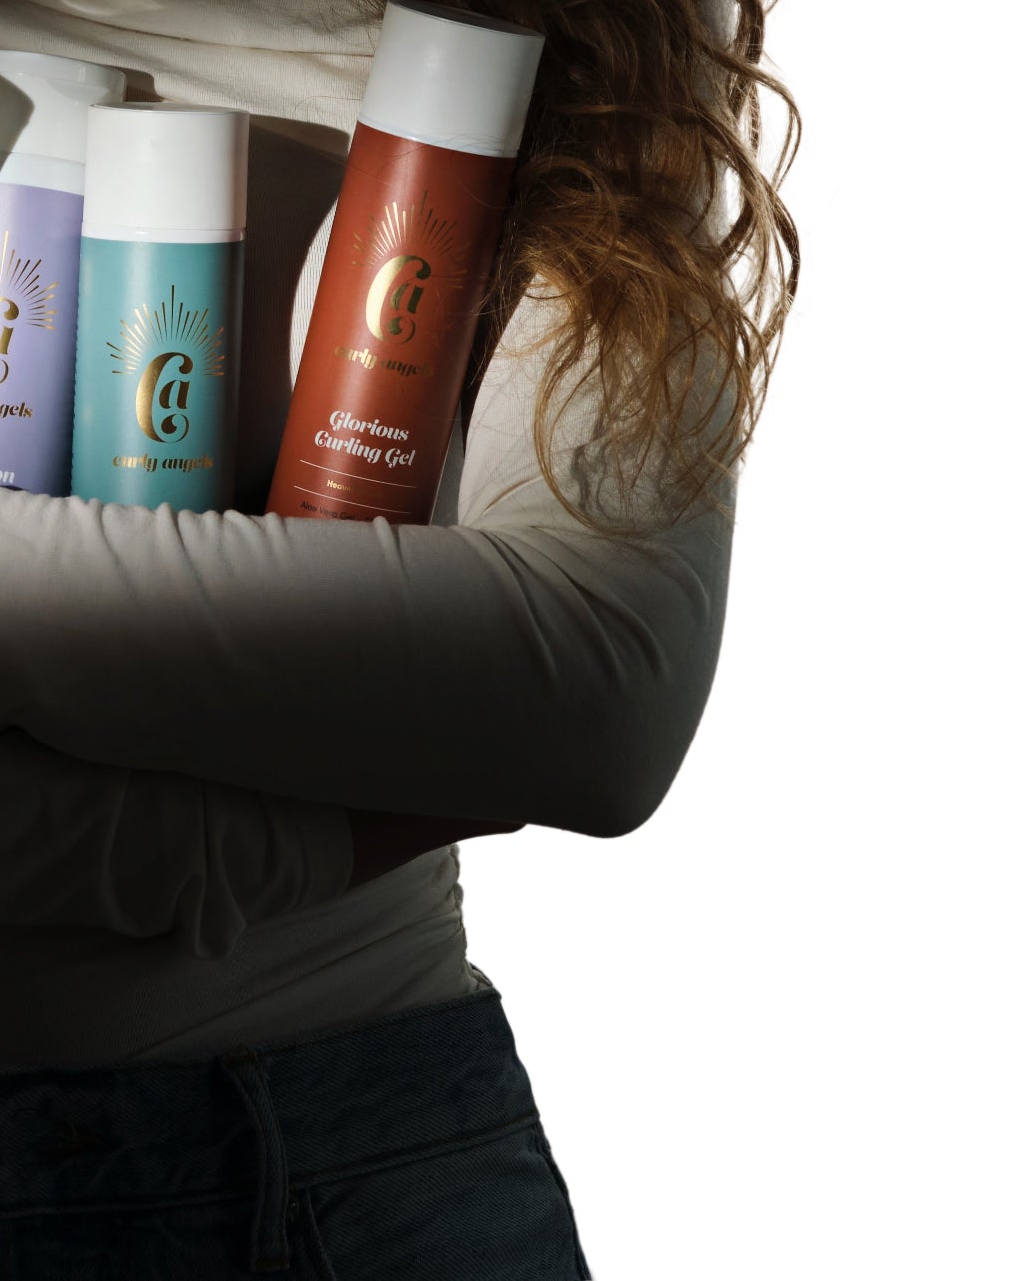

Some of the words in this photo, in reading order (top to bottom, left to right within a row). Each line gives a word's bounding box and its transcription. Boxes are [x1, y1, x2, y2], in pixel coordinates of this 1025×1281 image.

[335, 345, 377, 370] curly
[329, 409, 409, 442] Glorious
[314, 430, 382, 464] Curling
[385, 447, 416, 469] Gel
[112, 452, 158, 473] curly
[161, 453, 214, 473] angels
[299, 500, 318, 512] Aloe
[319, 505, 338, 518] Vera
